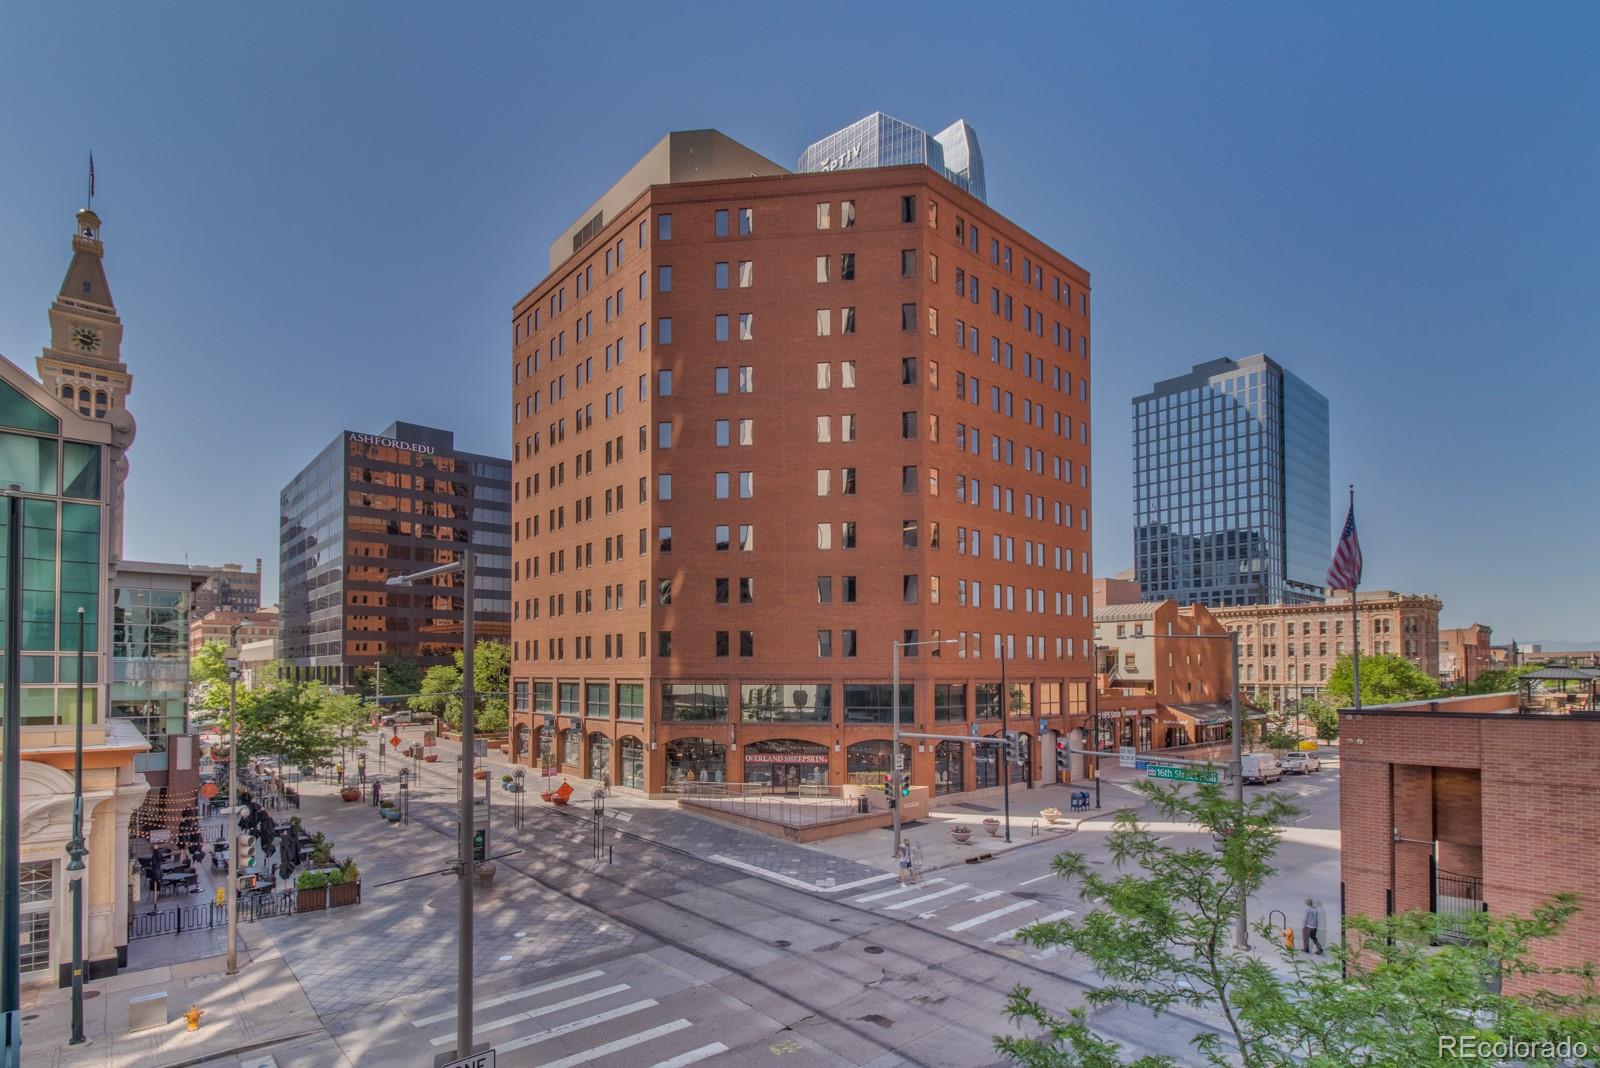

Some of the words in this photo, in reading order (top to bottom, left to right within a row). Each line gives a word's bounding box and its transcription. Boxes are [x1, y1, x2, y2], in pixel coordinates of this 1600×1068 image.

[349, 433, 434, 454] ASHFORD.EDU
[784, 755, 825, 763] SHEEPSKIN
[1157, 768, 1173, 777] 16th
[455, 1057, 486, 1068] NE
